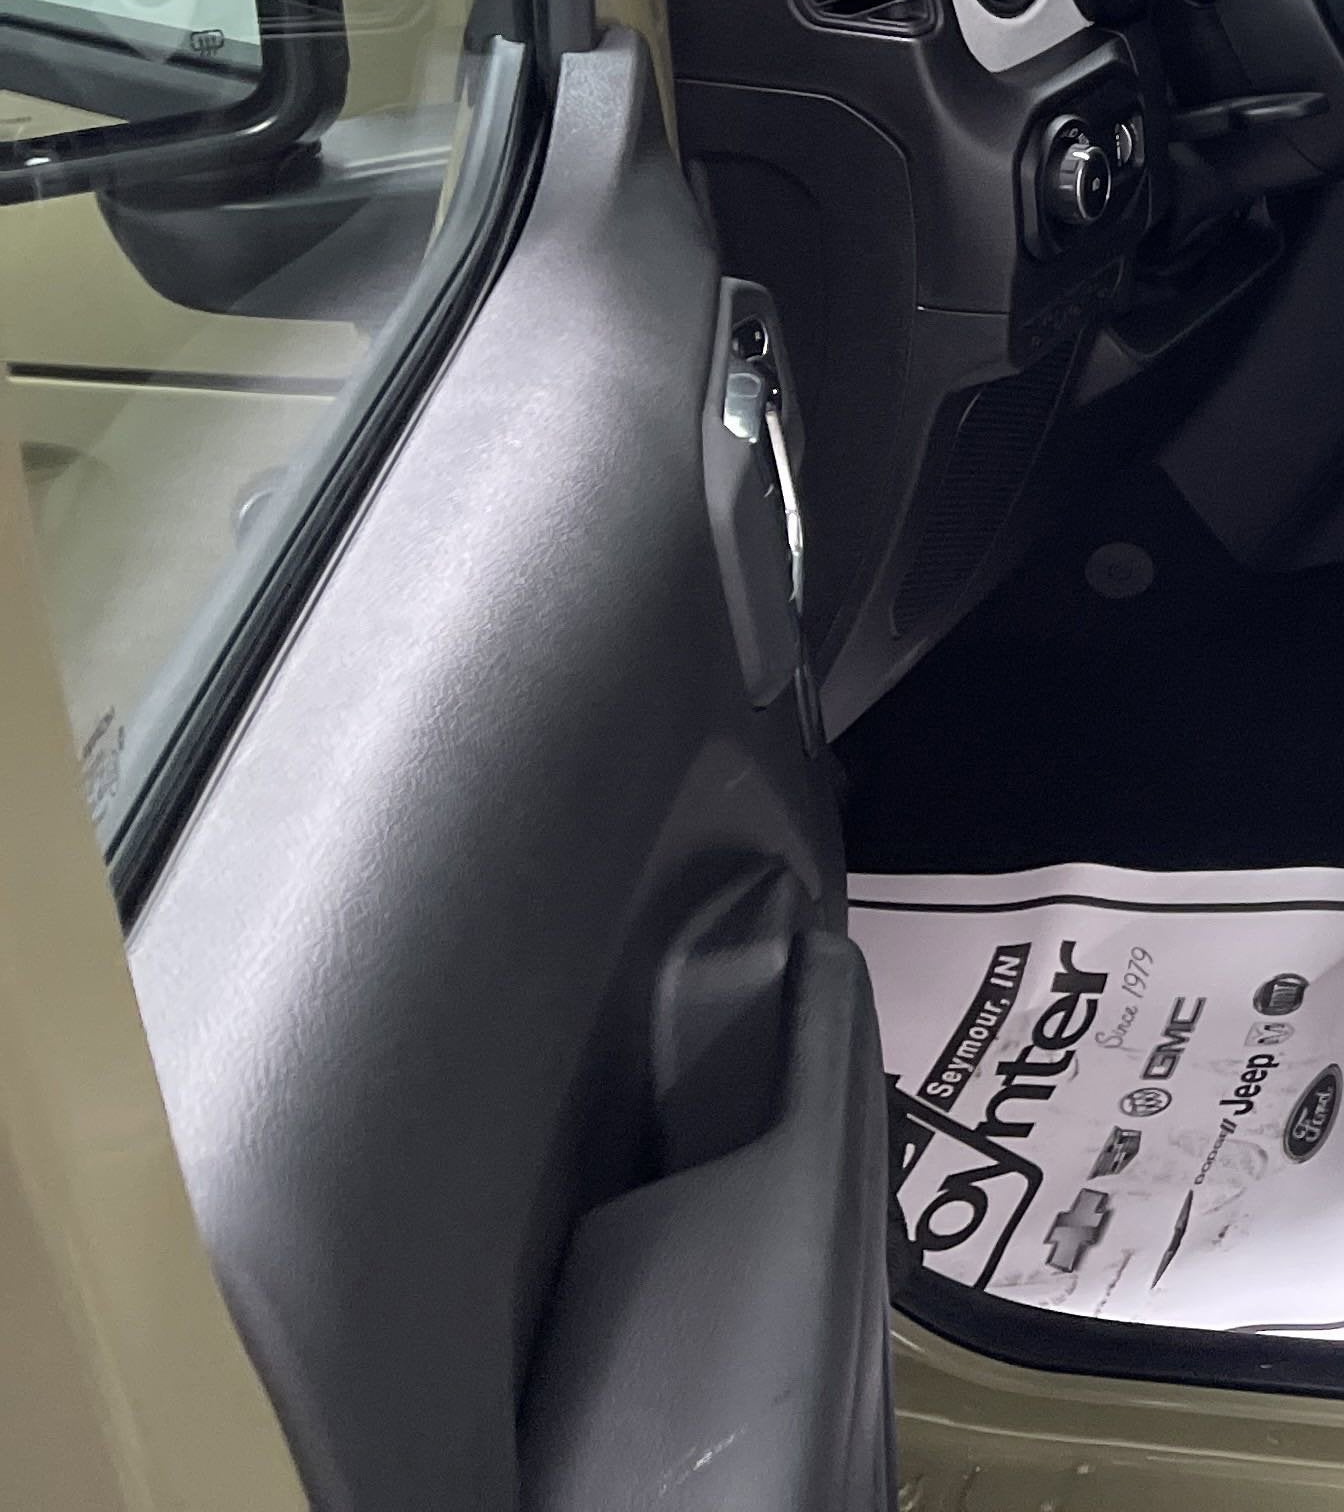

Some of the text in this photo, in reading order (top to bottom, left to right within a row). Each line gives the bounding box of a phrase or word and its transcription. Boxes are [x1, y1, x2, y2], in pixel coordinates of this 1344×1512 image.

[926, 955, 1021, 1098] Seymour, IN
[1094, 946, 1153, 1049] Since 1979
[1140, 996, 1206, 1080] GMC
[914, 940, 1108, 1254] oynter
[1219, 1053, 1280, 1116] Jeep
[1293, 1090, 1333, 1142] Ford
